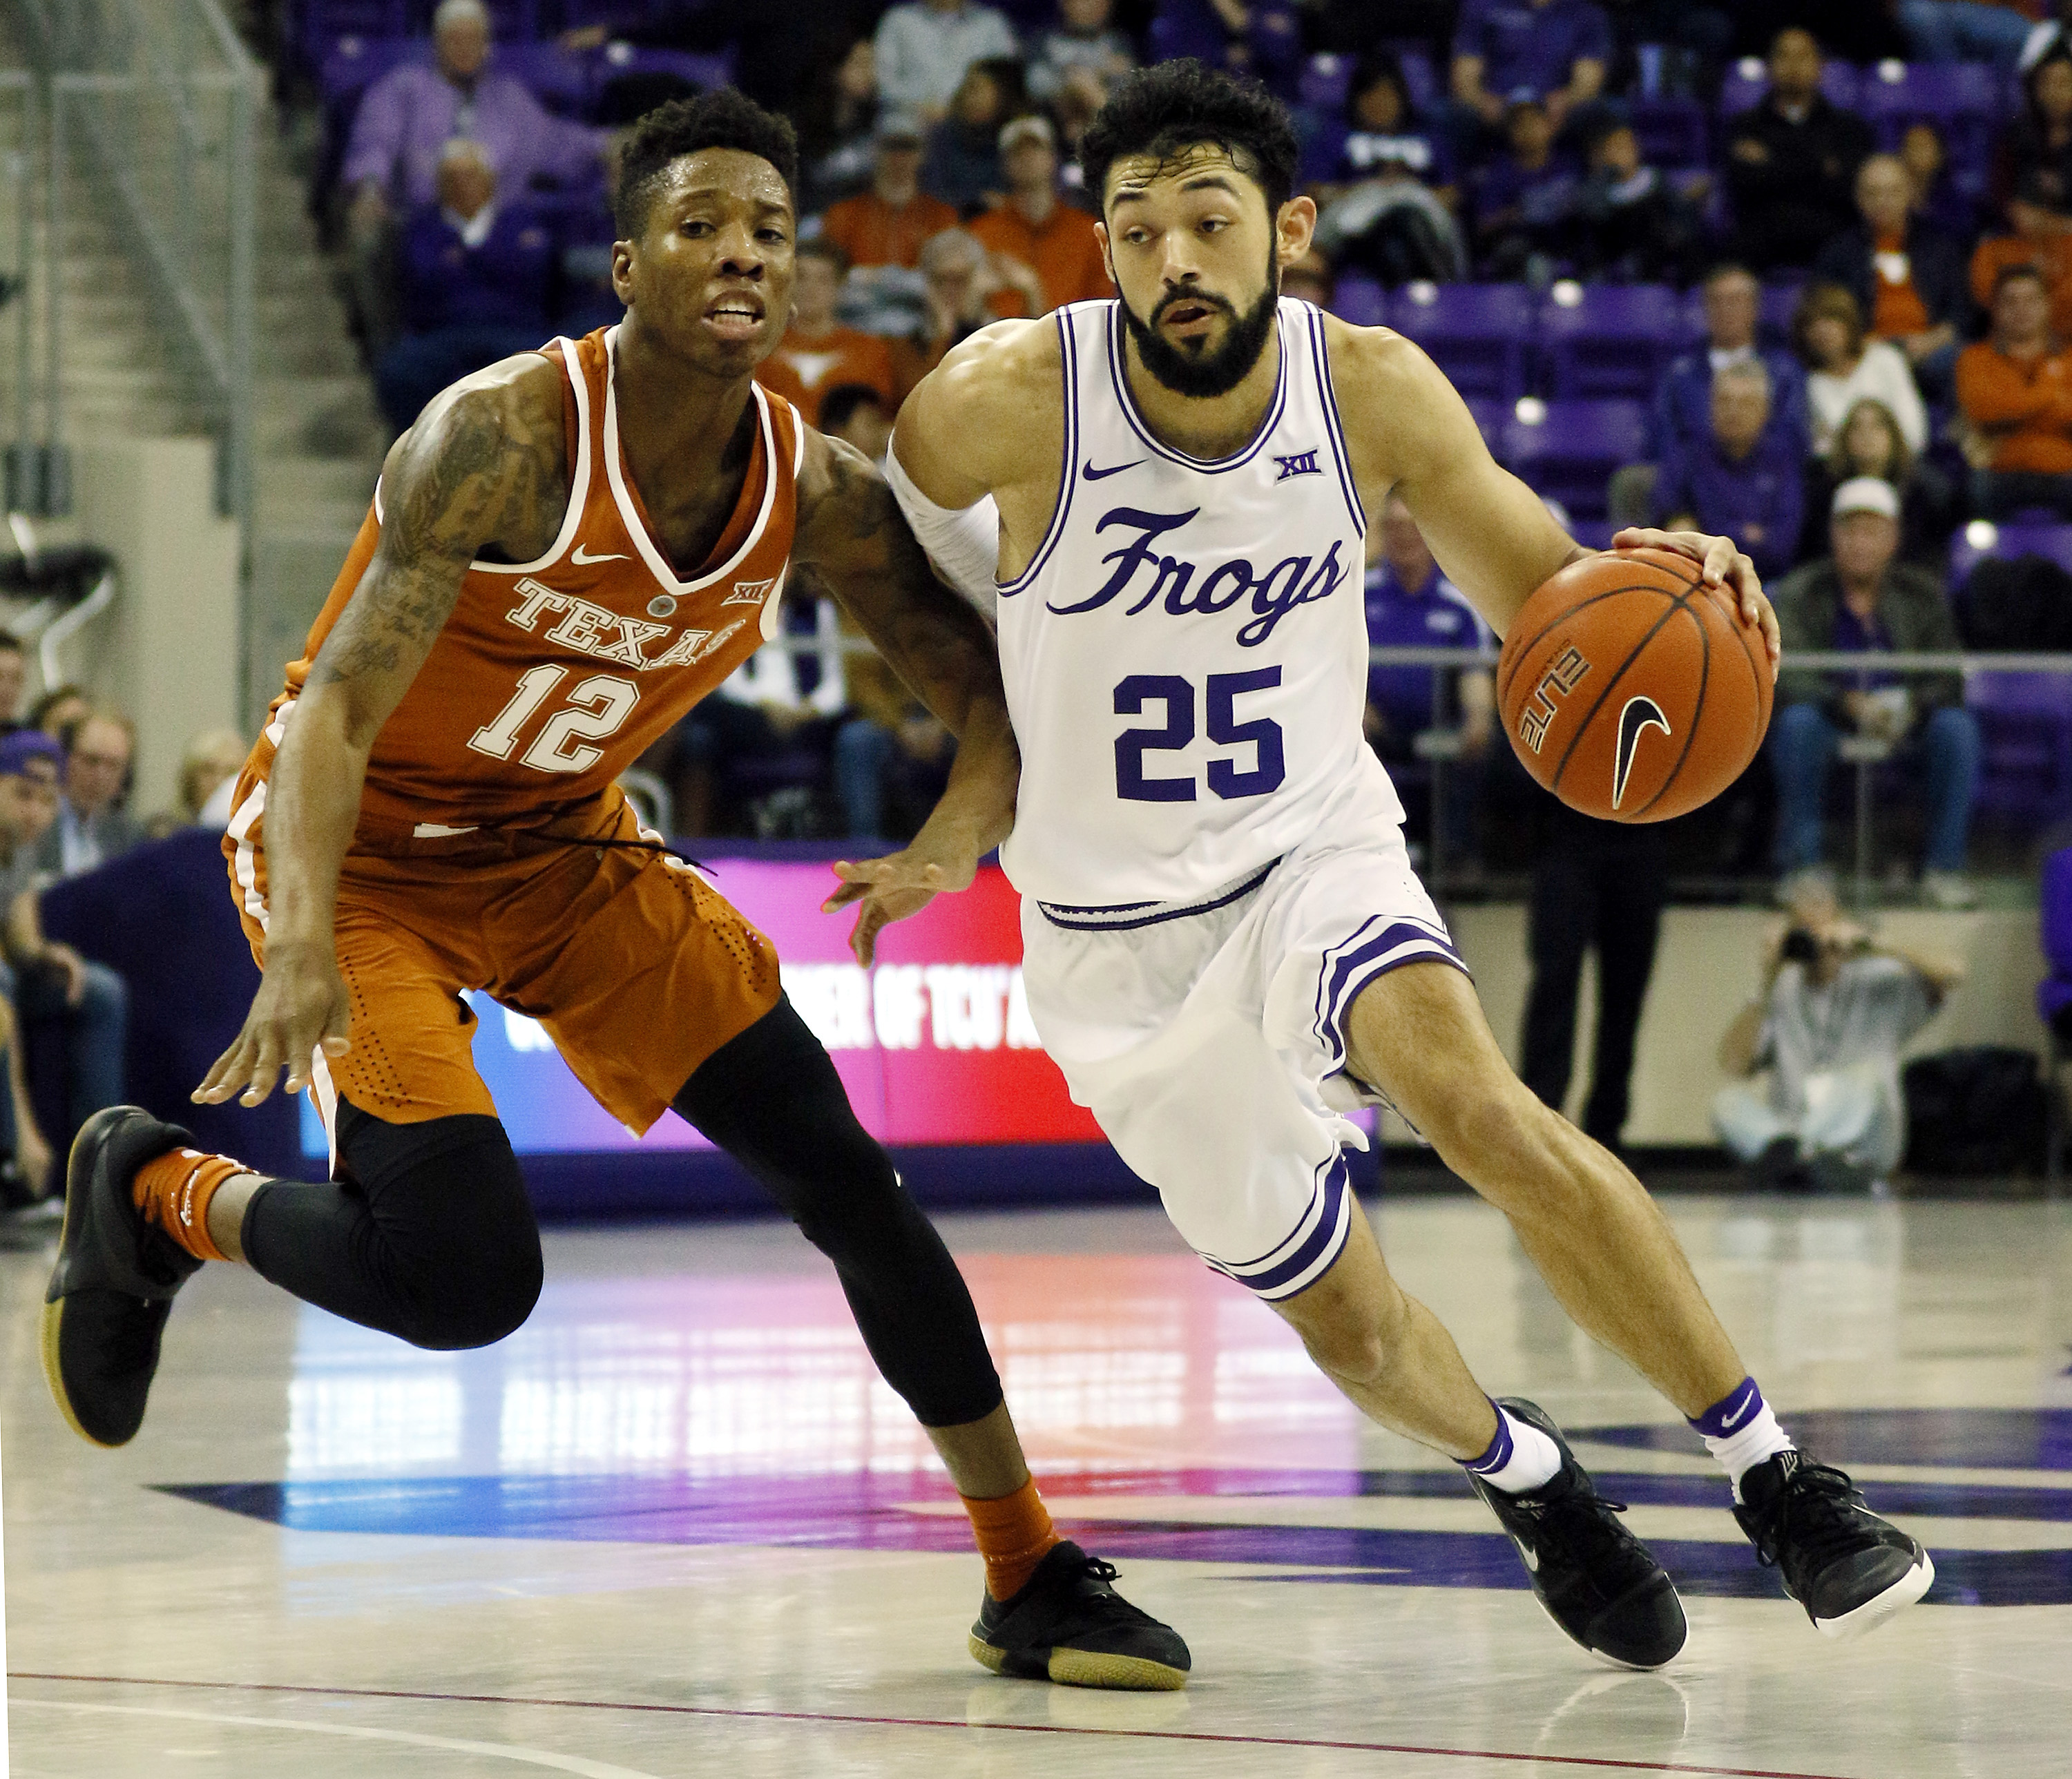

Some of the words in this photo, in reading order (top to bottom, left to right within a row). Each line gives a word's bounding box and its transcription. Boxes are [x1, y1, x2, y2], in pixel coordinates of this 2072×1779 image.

[1272, 448, 1323, 481] XII
[505, 577, 746, 671] TEXAS
[720, 578, 774, 606] XII
[1046, 507, 1352, 647] Frogs
[466, 663, 640, 773] 12
[1113, 665, 1285, 802] 25
[1520, 646, 1592, 754] ELITE
